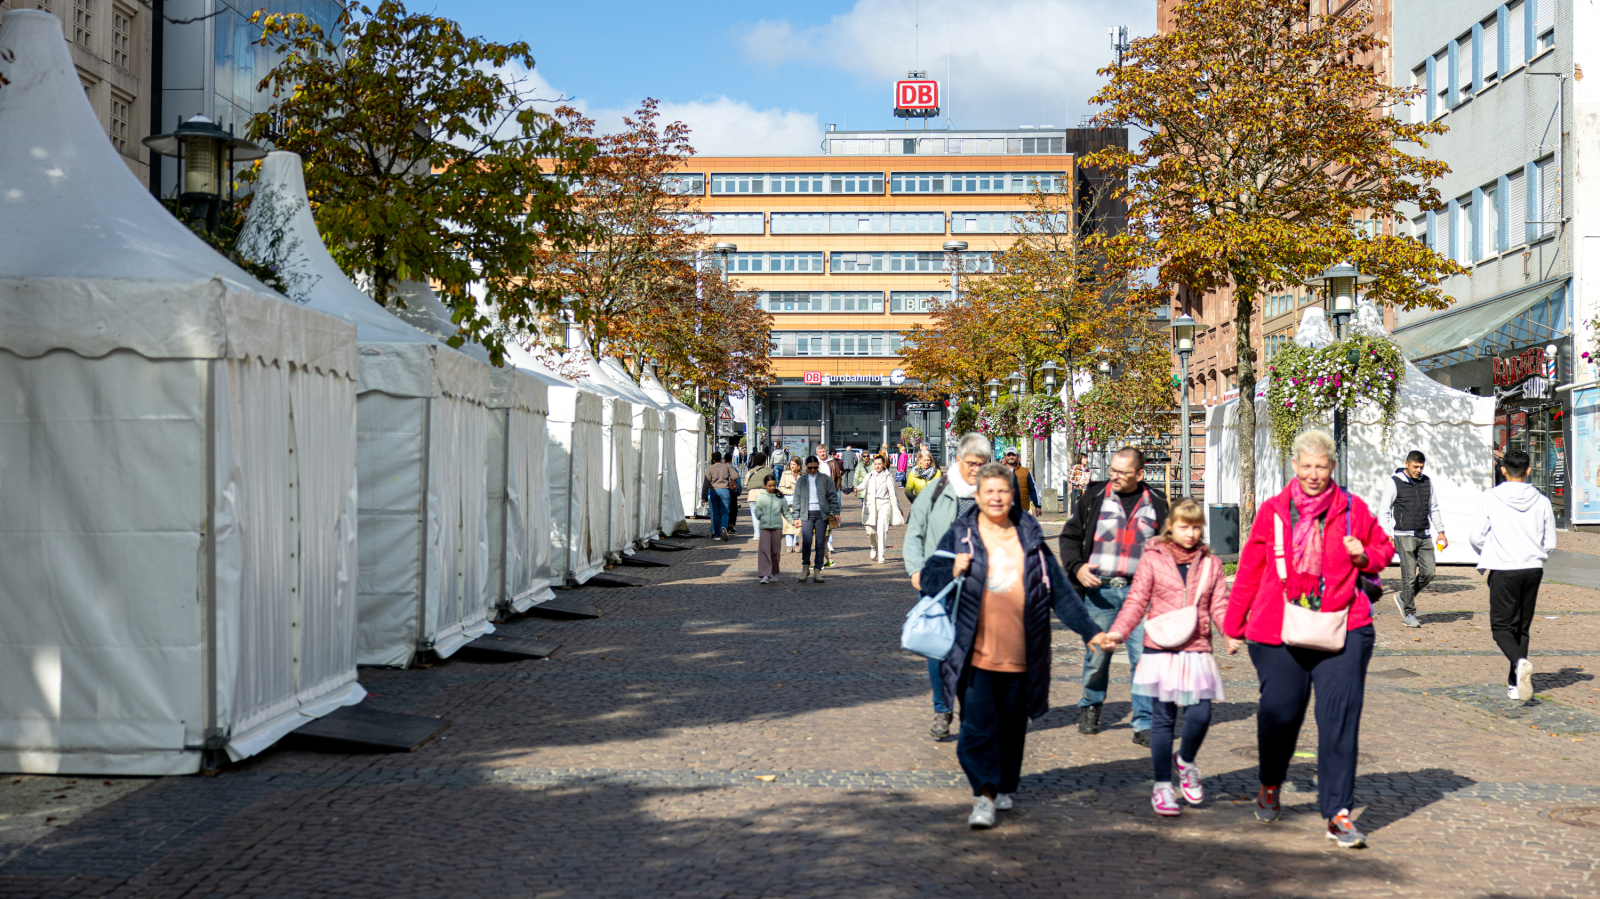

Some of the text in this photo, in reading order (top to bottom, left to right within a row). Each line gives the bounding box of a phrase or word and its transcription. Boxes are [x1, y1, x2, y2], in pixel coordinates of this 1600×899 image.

[902, 85, 933, 104] DB
[1492, 347, 1545, 386] BARBER
[806, 373, 883, 382] DB Eurobahnhof
[1522, 376, 1549, 399] SHOP
